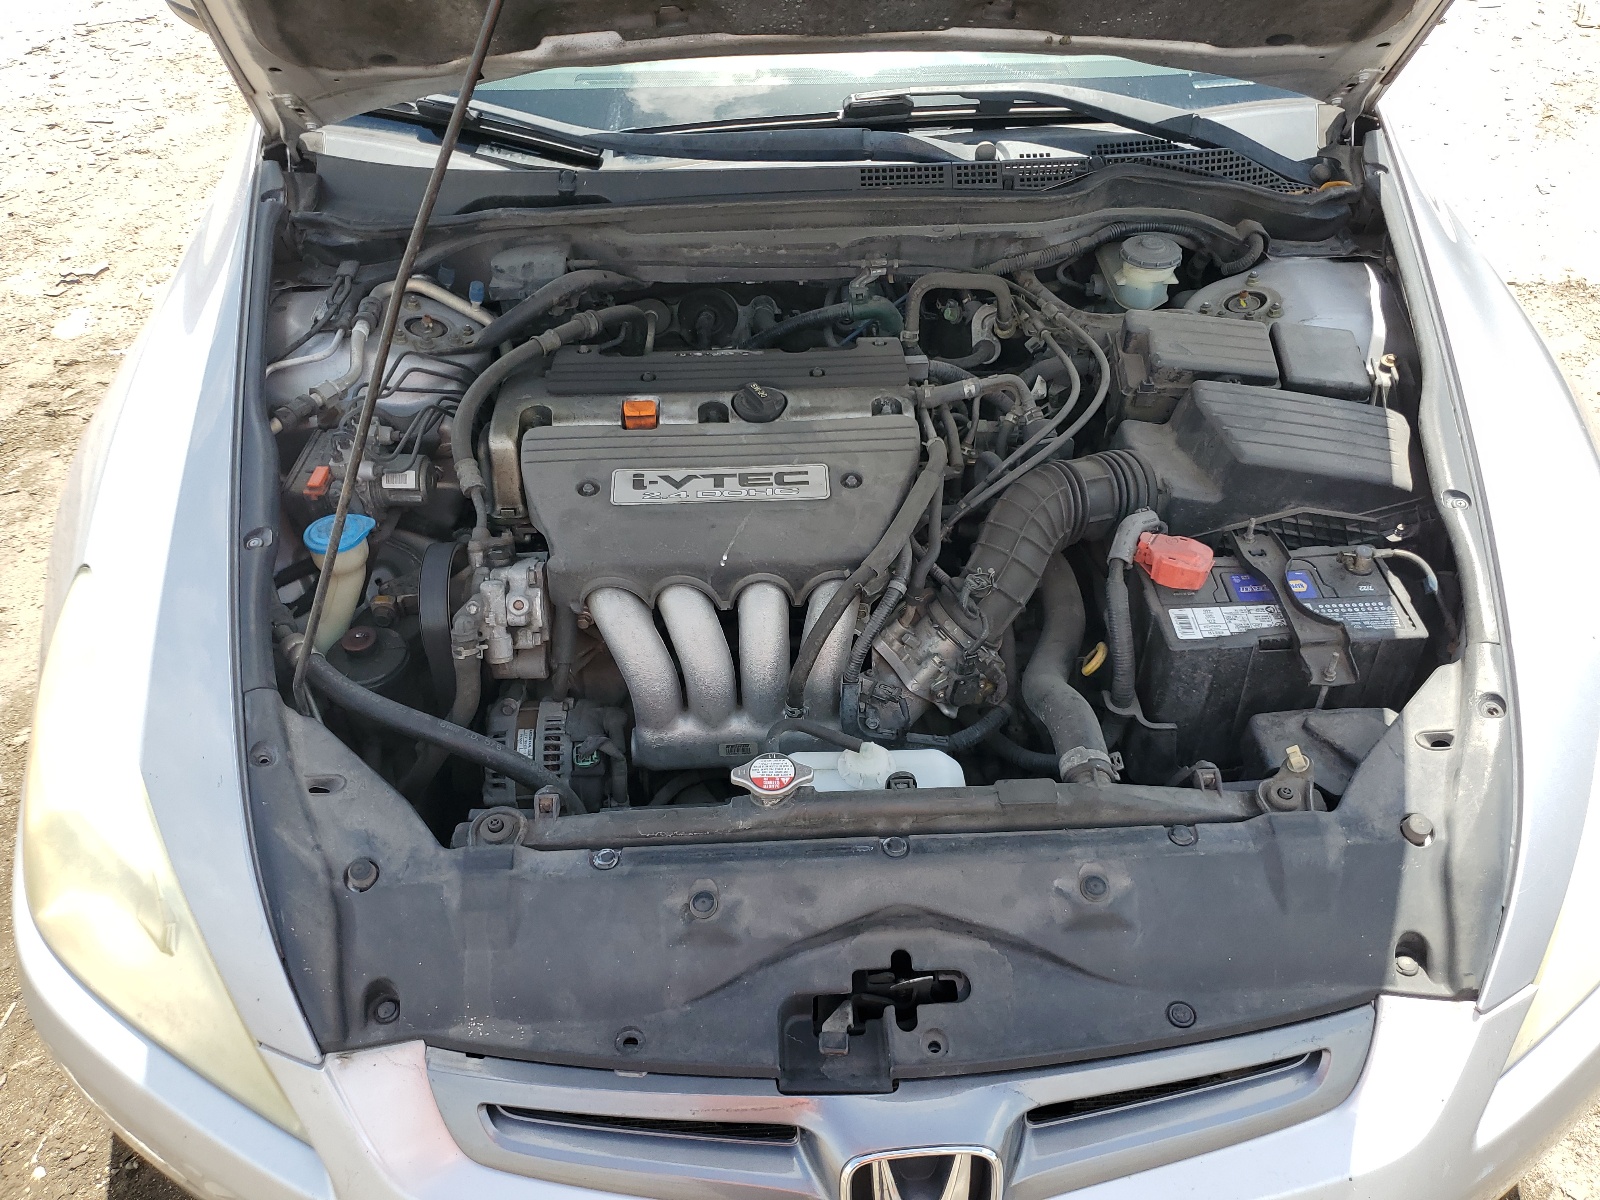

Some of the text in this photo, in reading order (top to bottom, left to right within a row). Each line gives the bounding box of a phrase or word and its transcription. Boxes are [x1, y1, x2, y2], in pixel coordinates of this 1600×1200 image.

[632, 471, 810, 491] i-VTEC
[642, 487, 800, 500] 2.4 DOHC
